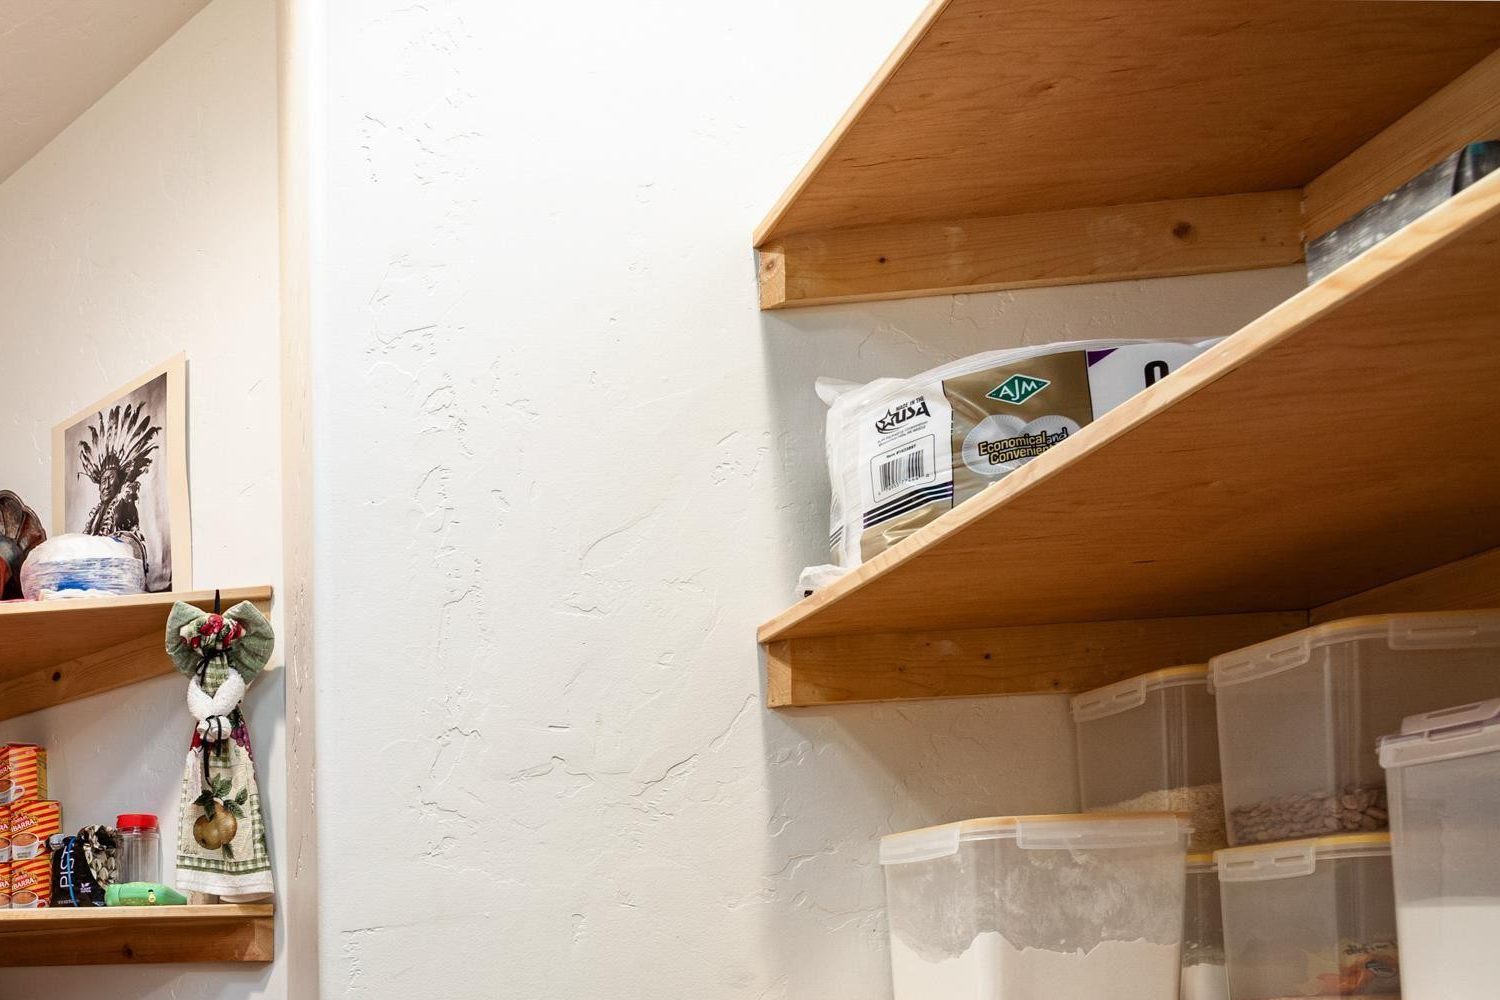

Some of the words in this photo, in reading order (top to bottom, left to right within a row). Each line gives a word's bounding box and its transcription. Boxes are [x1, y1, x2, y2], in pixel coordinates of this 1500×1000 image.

[999, 379, 1037, 401] AJM
[895, 401, 931, 424] USA
[978, 430, 1047, 457] Economical
[1046, 427, 1069, 445] and
[989, 443, 1055, 466] Convenien
